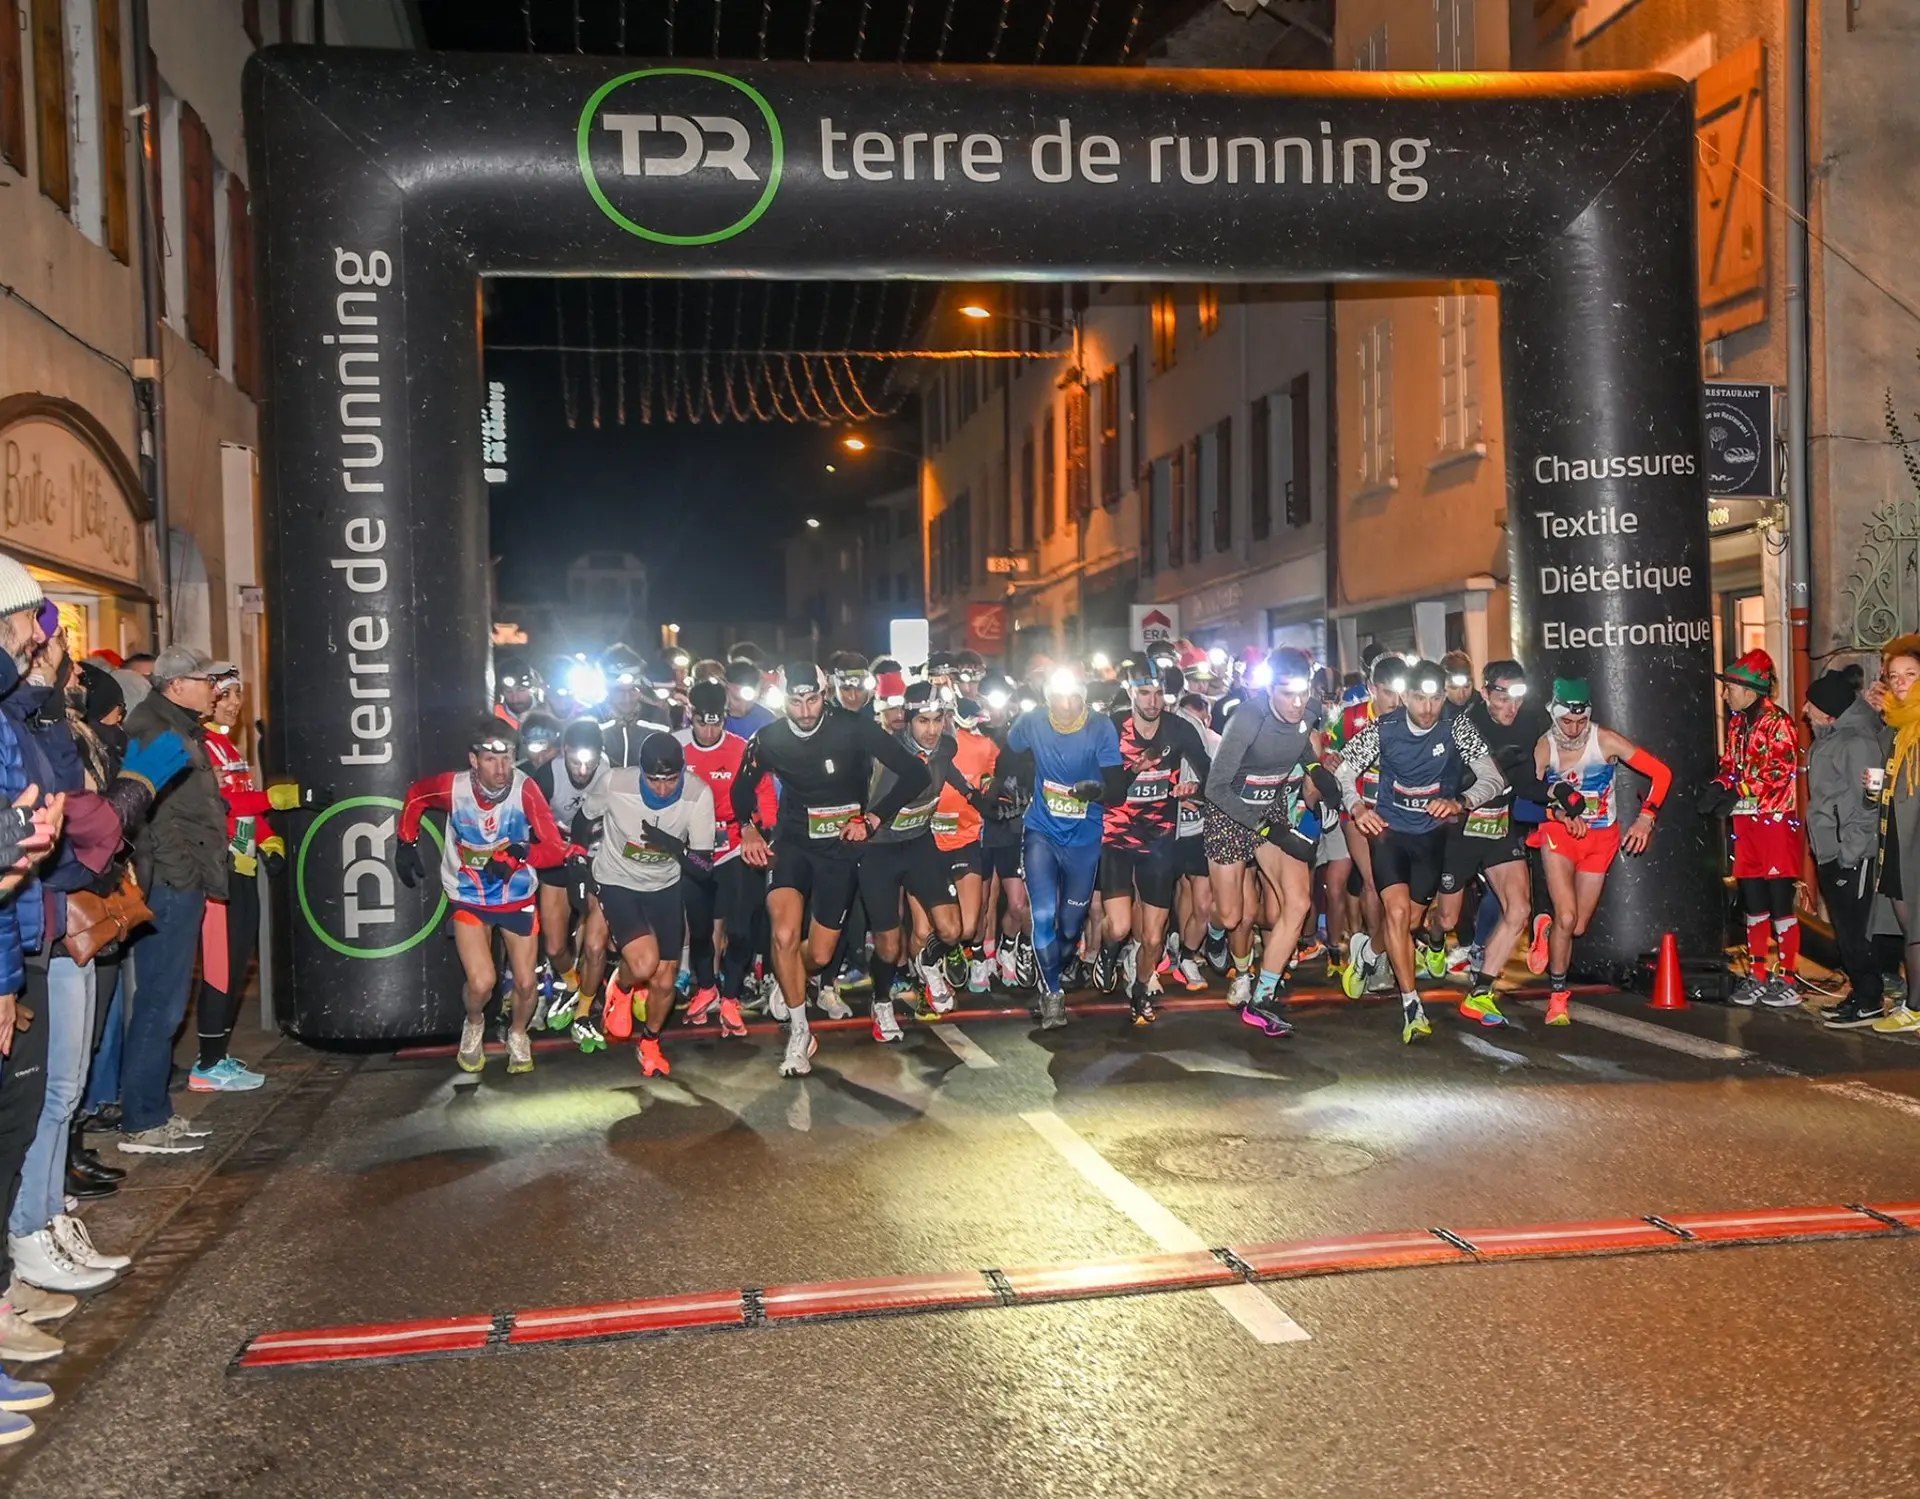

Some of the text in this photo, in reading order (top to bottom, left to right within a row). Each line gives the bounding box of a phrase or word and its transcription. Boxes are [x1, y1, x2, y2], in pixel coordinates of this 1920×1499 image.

[602, 114, 761, 181] TDR
[820, 117, 1432, 203] terre de running
[1705, 388, 1760, 398] RESTAURANT
[1535, 453, 1696, 484] Chaussures
[322, 246, 393, 766] terre de running
[1536, 506, 1639, 540] Textile
[1541, 561, 1692, 595] Diététique
[1143, 629, 1170, 640] ERA
[1543, 615, 1711, 650] Electronique
[1134, 785, 1158, 797] 151
[1252, 789, 1277, 800] 193
[1403, 798, 1429, 808] 187
[816, 821, 840, 833] 48
[342, 814, 396, 938] TDR
